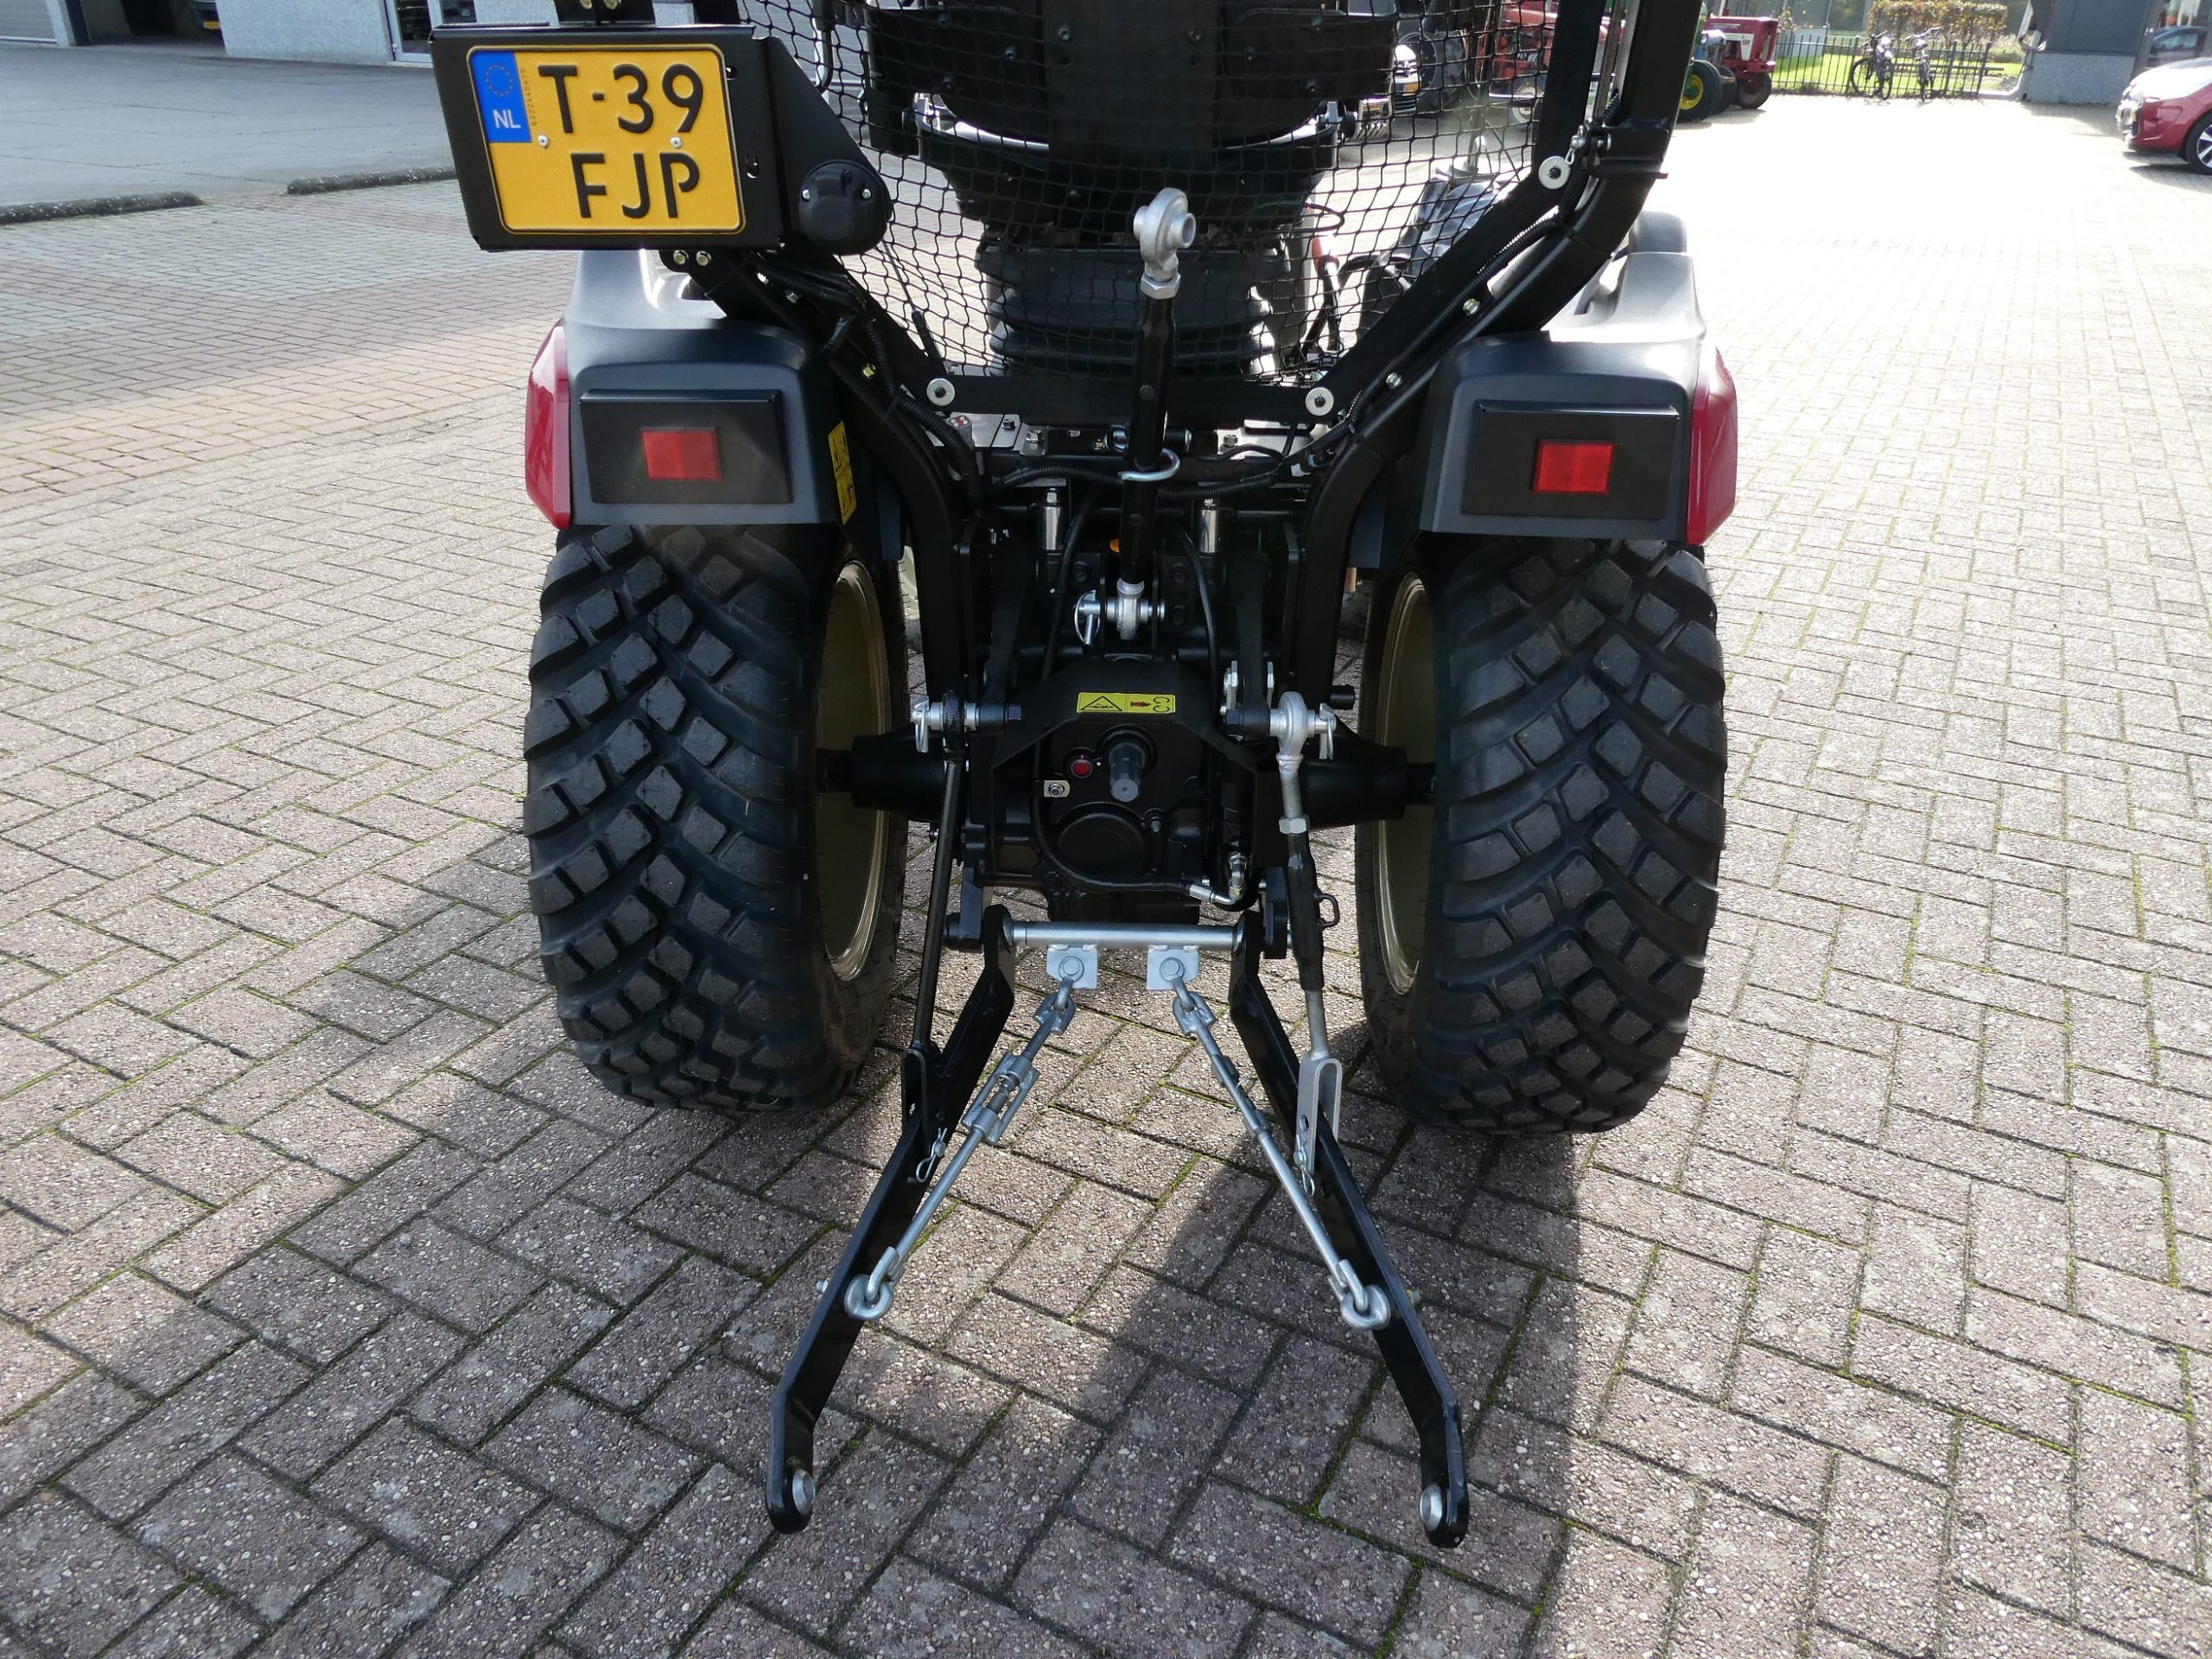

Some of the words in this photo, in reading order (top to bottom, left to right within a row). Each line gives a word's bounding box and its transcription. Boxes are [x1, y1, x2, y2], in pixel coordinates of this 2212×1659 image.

[493, 109, 521, 129] NL
[538, 65, 704, 134] T-39
[570, 153, 701, 219] FJP
